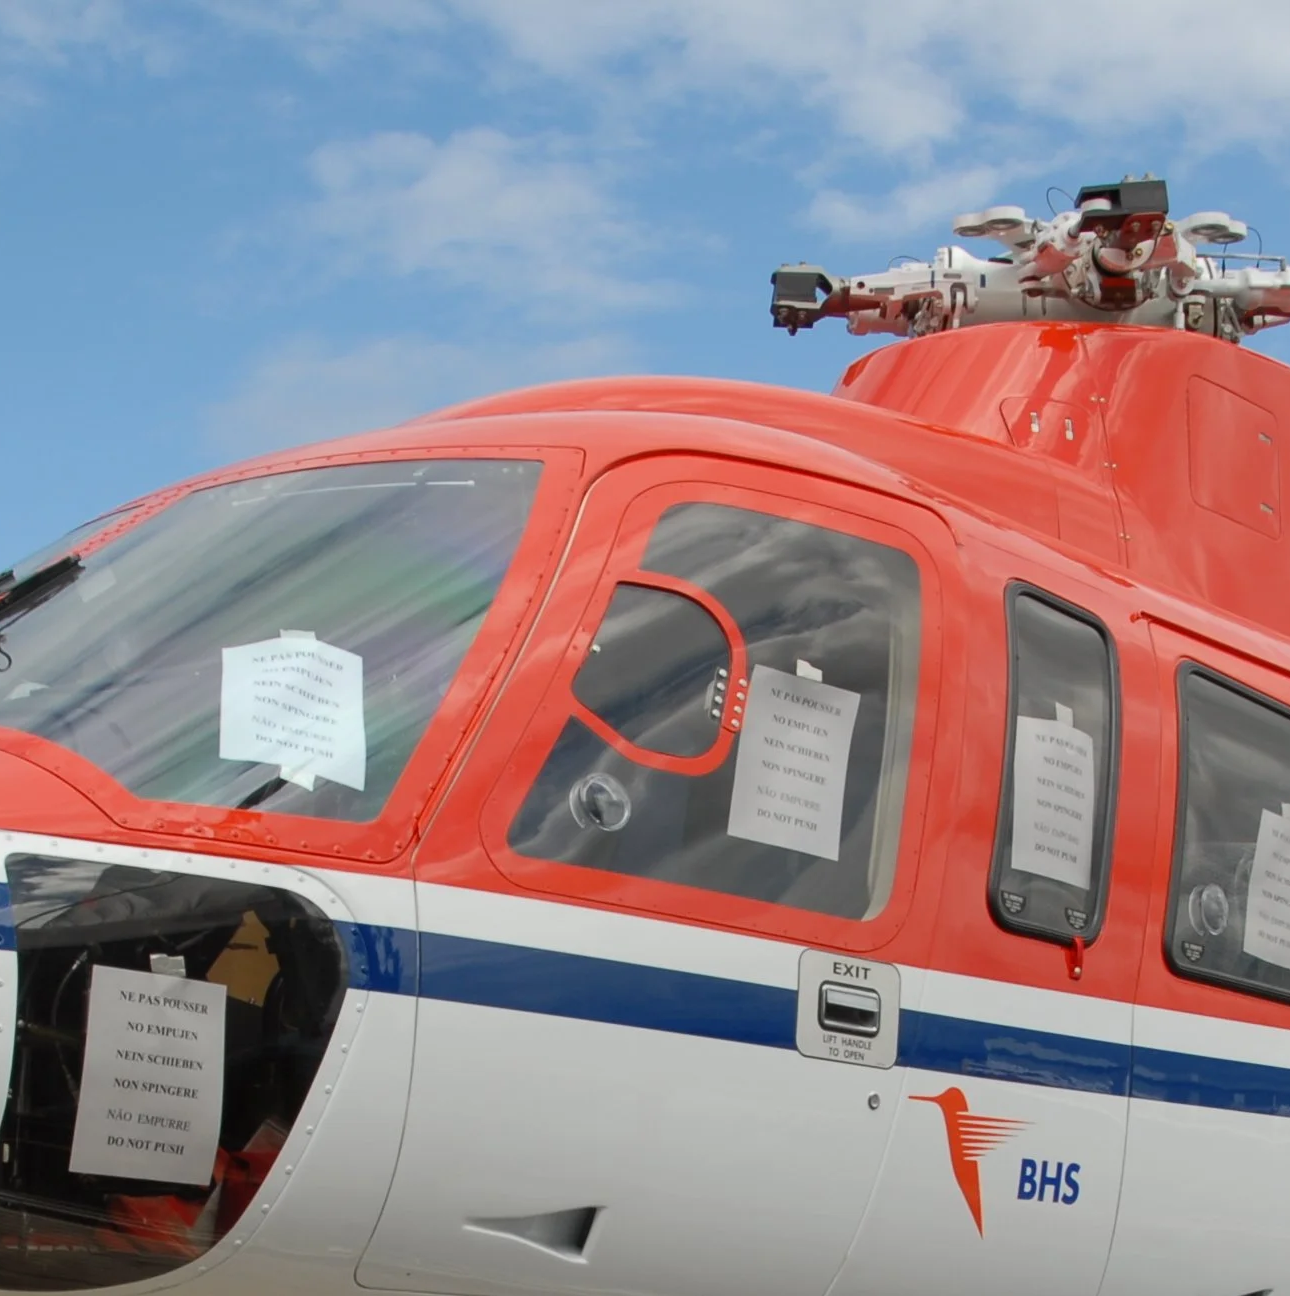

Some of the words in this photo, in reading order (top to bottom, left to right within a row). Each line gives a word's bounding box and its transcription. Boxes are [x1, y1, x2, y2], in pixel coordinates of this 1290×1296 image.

[772, 713, 786, 725] NO
[757, 808, 771, 819] DO
[772, 812, 792, 824] NOT
[794, 818, 818, 832] PUSH
[833, 962, 871, 980] EXIT
[120, 990, 136, 1002] NE
[138, 993, 161, 1007] PAS
[163, 997, 209, 1015] POUSSER
[126, 1021, 144, 1033] NO
[147, 1024, 199, 1041] EMPUJEN
[822, 1034, 837, 1045] LIFT
[841, 1037, 872, 1051] HANDLE
[116, 1049, 145, 1062] NEIN
[147, 1054, 204, 1071] SCHIEBEN
[829, 1047, 839, 1057] TO
[843, 1049, 865, 1061] OPEN
[113, 1078, 140, 1090] NON
[141, 1082, 199, 1100] SPINGERE
[137, 1113, 192, 1132] EMPURRE
[107, 1135, 124, 1147] DO
[125, 1138, 152, 1151] NOT
[153, 1142, 185, 1155] PUSH
[1017, 1158, 1081, 1205] BHS
